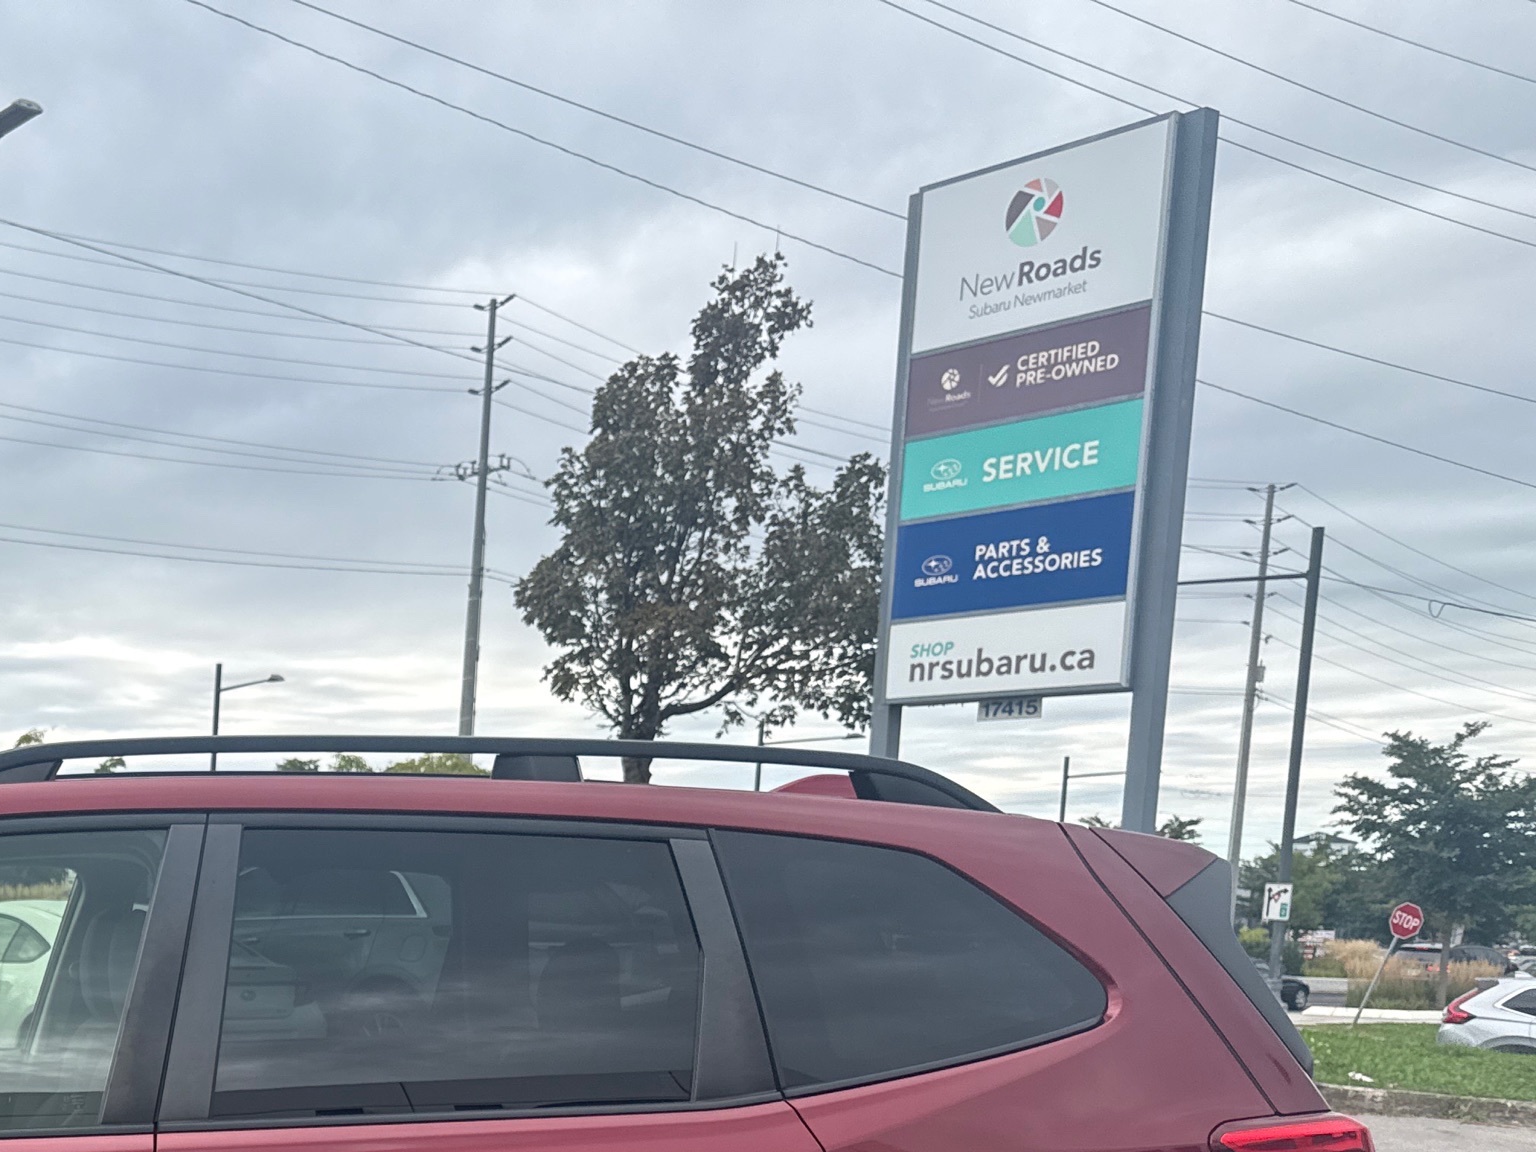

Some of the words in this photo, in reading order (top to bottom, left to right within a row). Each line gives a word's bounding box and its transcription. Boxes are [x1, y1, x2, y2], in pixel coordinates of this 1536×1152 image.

[968, 299, 1011, 320] Subaru
[1014, 280, 1088, 308] Newmarket
[1016, 340, 1100, 371] CERTIFIED
[1015, 353, 1119, 388] PRE-OWNED
[982, 440, 1100, 483] SERVICE
[923, 478, 968, 493] SUBARU
[974, 538, 1030, 562] PARTS
[1036, 535, 1051, 554] &
[972, 548, 1103, 580] ACCESSORIES
[914, 574, 959, 588] SUBARU
[910, 641, 954, 659] SHOP
[908, 648, 1095, 683] nrsubaru.ca
[981, 700, 1039, 718] 17415
[1392, 910, 1421, 930] STOP
